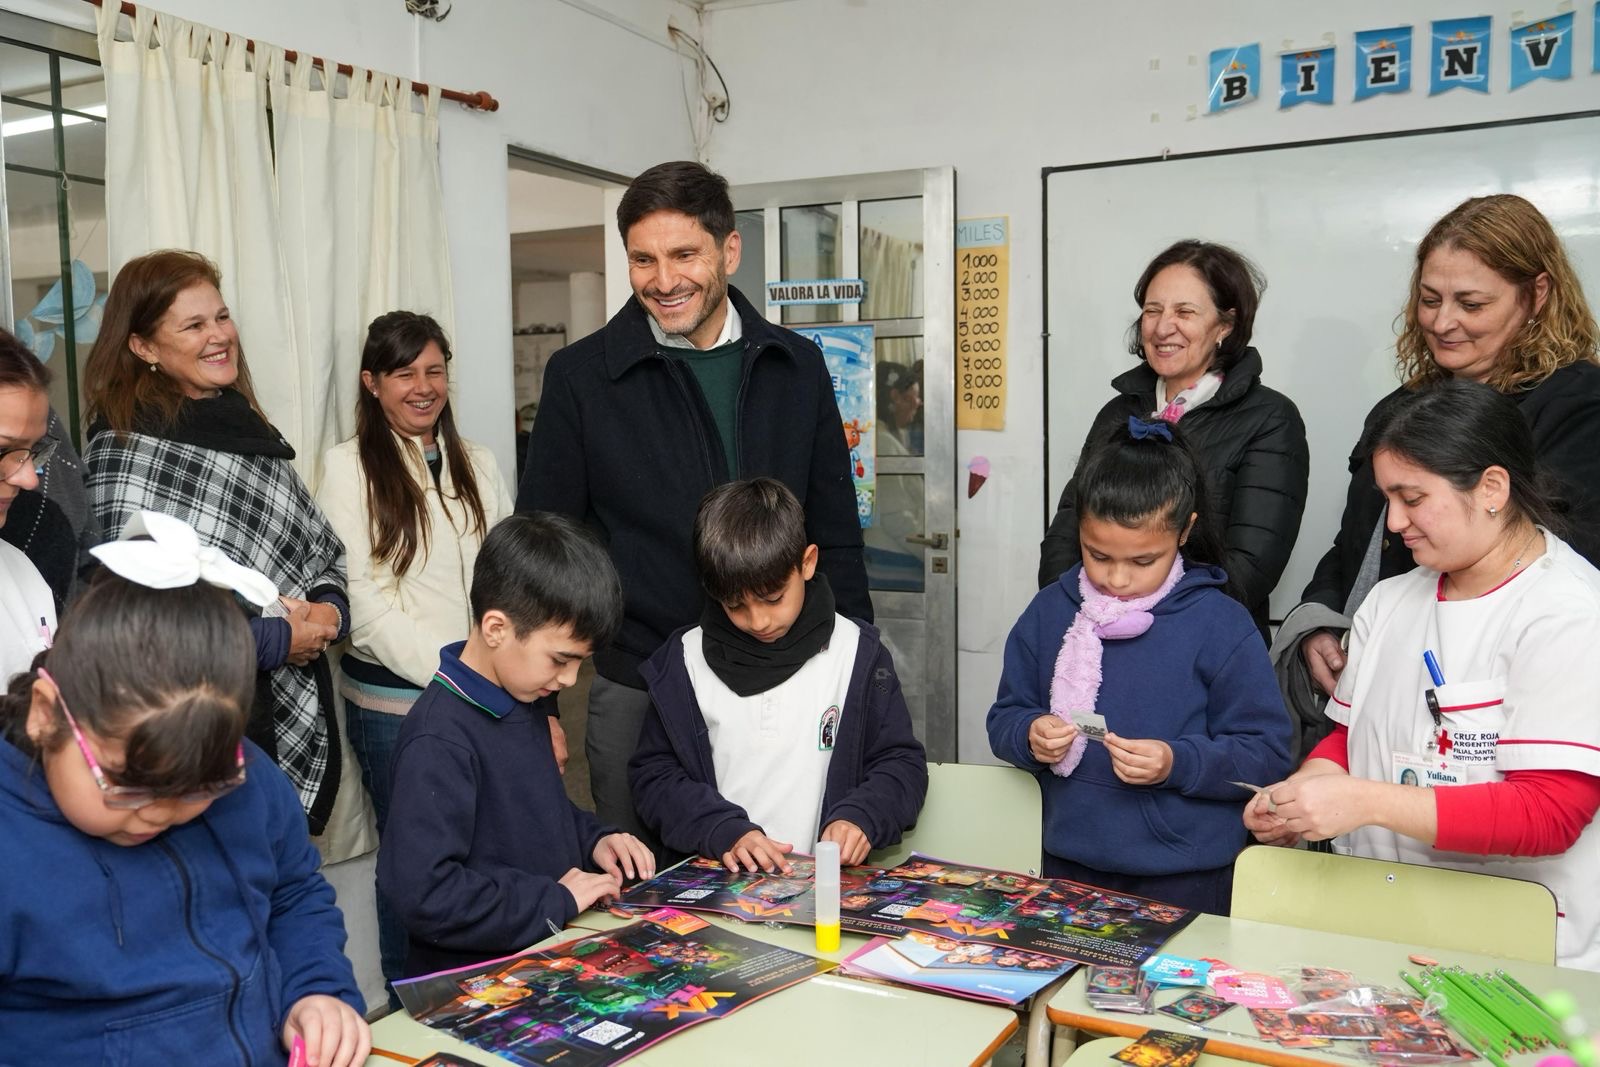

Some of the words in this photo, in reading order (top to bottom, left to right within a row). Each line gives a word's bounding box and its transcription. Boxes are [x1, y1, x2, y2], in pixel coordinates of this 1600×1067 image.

[957, 224, 1005, 243] MILES
[962, 253, 998, 269] 1.000
[961, 271, 997, 286] 2.000
[769, 286, 814, 301] VALORA
[817, 284, 830, 299] LA
[833, 284, 862, 299] VIDA
[962, 287, 999, 302] 3.000
[960, 306, 999, 320] 4.000
[959, 321, 999, 337] 5.000
[960, 338, 1001, 353] 6.000
[962, 357, 1002, 372] 7.000
[963, 373, 1002, 389] 8.000
[963, 392, 1000, 410] 9.000
[1453, 732, 1477, 741] CRUZ
[1480, 732, 1500, 741] ROJA
[1426, 770, 1457, 783] Yuliana
